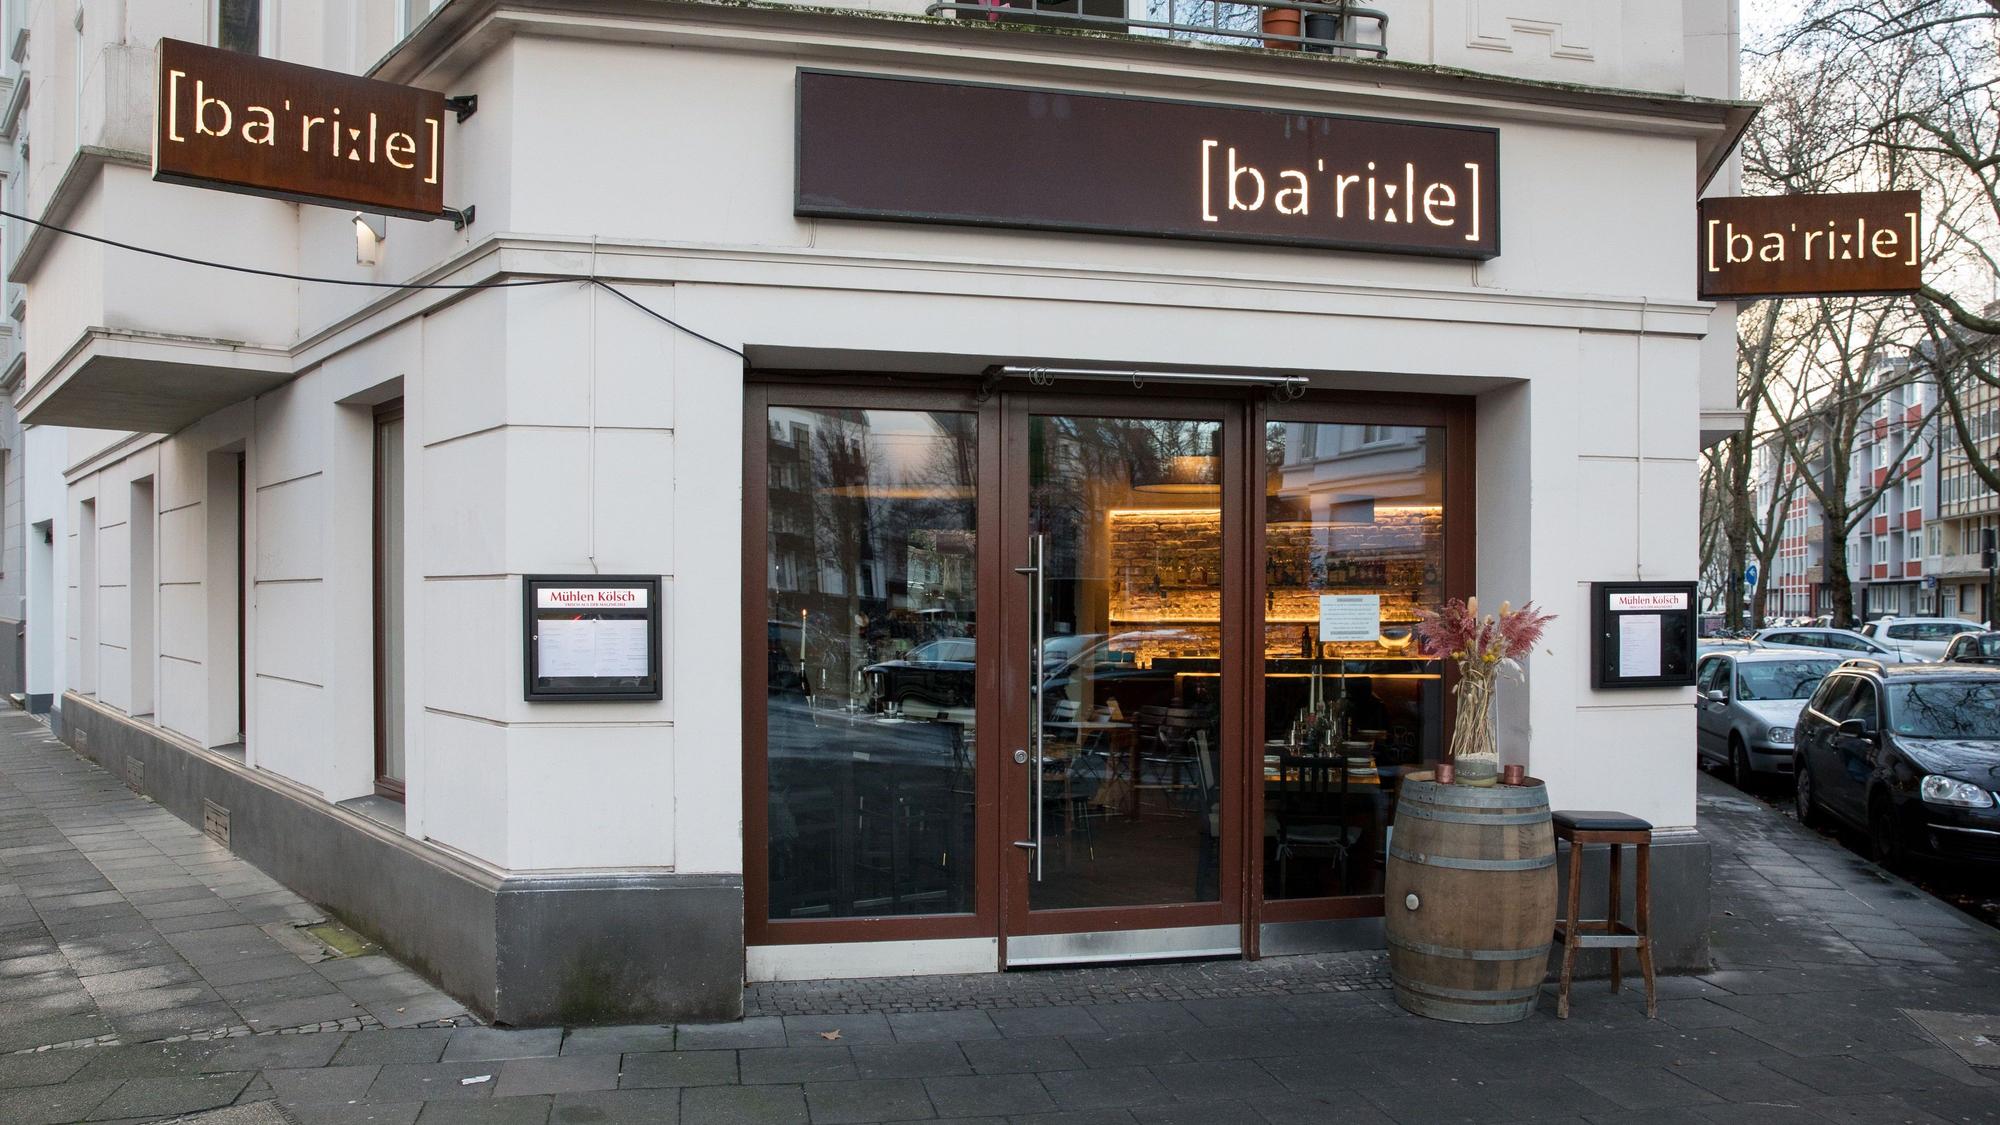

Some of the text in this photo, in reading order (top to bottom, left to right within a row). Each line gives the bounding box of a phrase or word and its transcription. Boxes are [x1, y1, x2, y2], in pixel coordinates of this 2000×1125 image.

[550, 591, 635, 602] Mühlen Kölsch
[1619, 595, 1679, 605] Mühlen Kölsch
